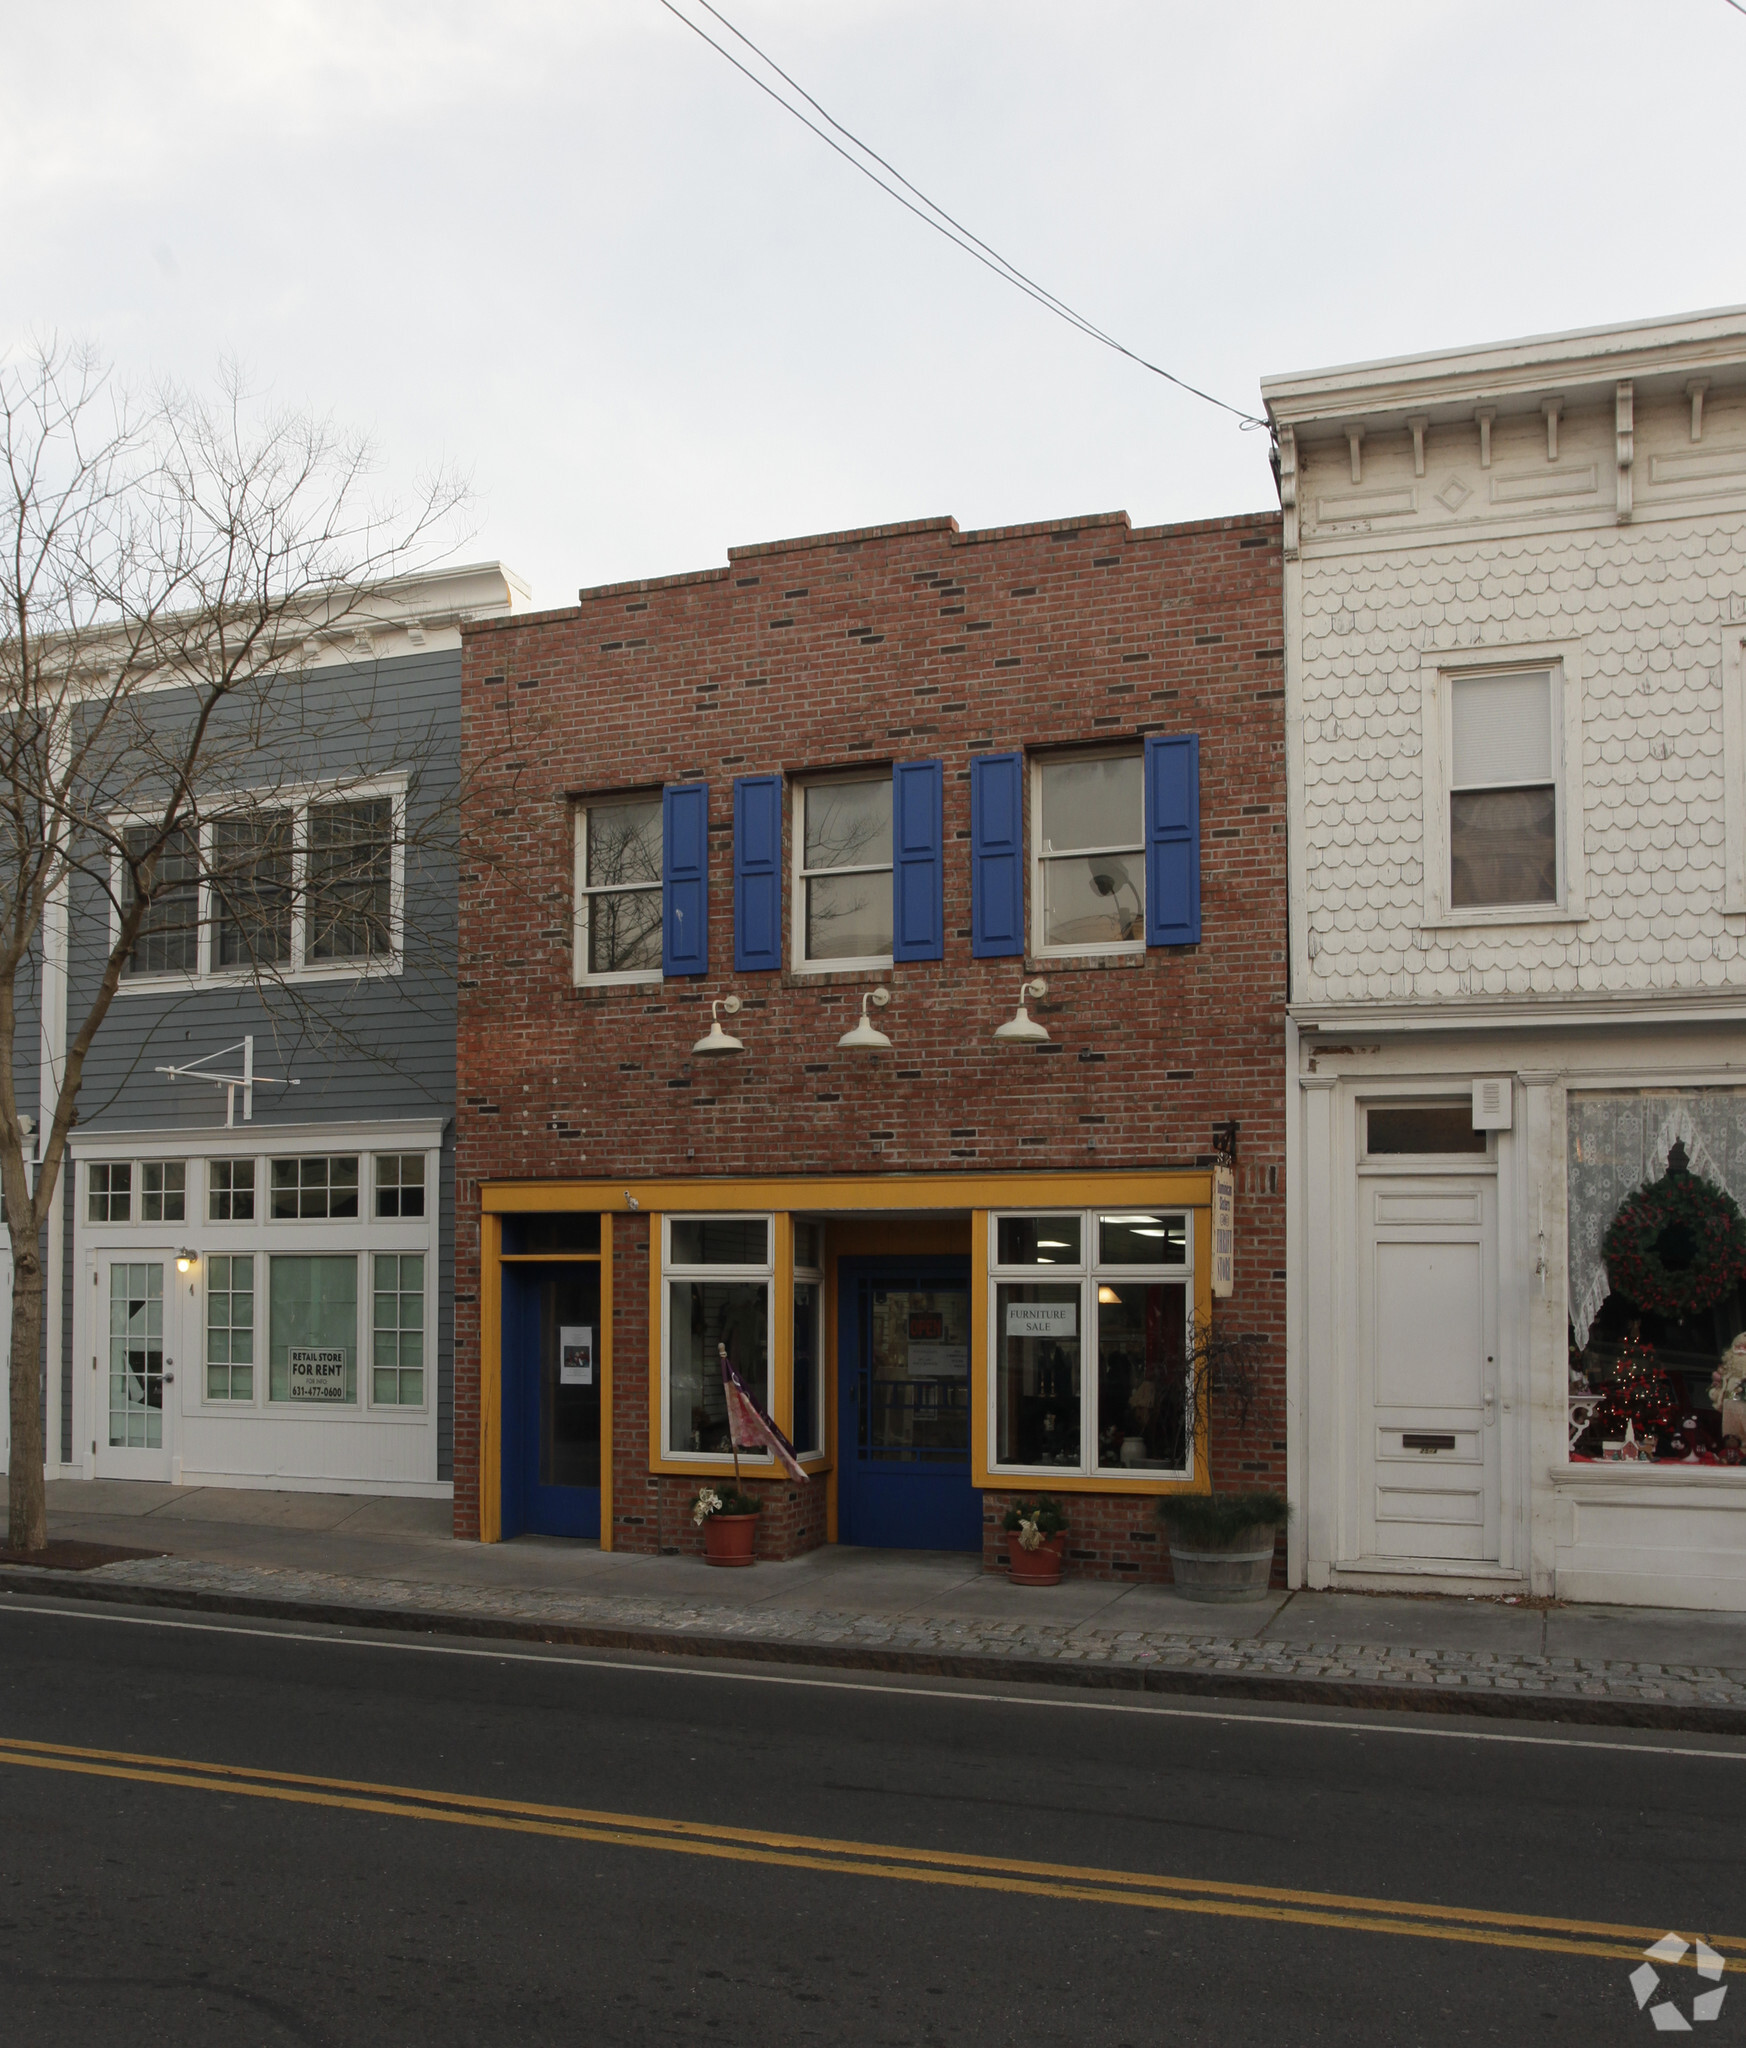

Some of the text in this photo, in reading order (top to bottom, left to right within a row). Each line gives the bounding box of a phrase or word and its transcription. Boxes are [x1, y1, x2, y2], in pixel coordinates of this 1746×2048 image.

[1010, 1310, 1066, 1319] FURNITURE
[1026, 1322, 1051, 1331] SALE
[293, 1353, 342, 1362] RETAIL STORE
[293, 1364, 342, 1376] FOR RENT
[292, 1386, 342, 1397] 631-477-0600
